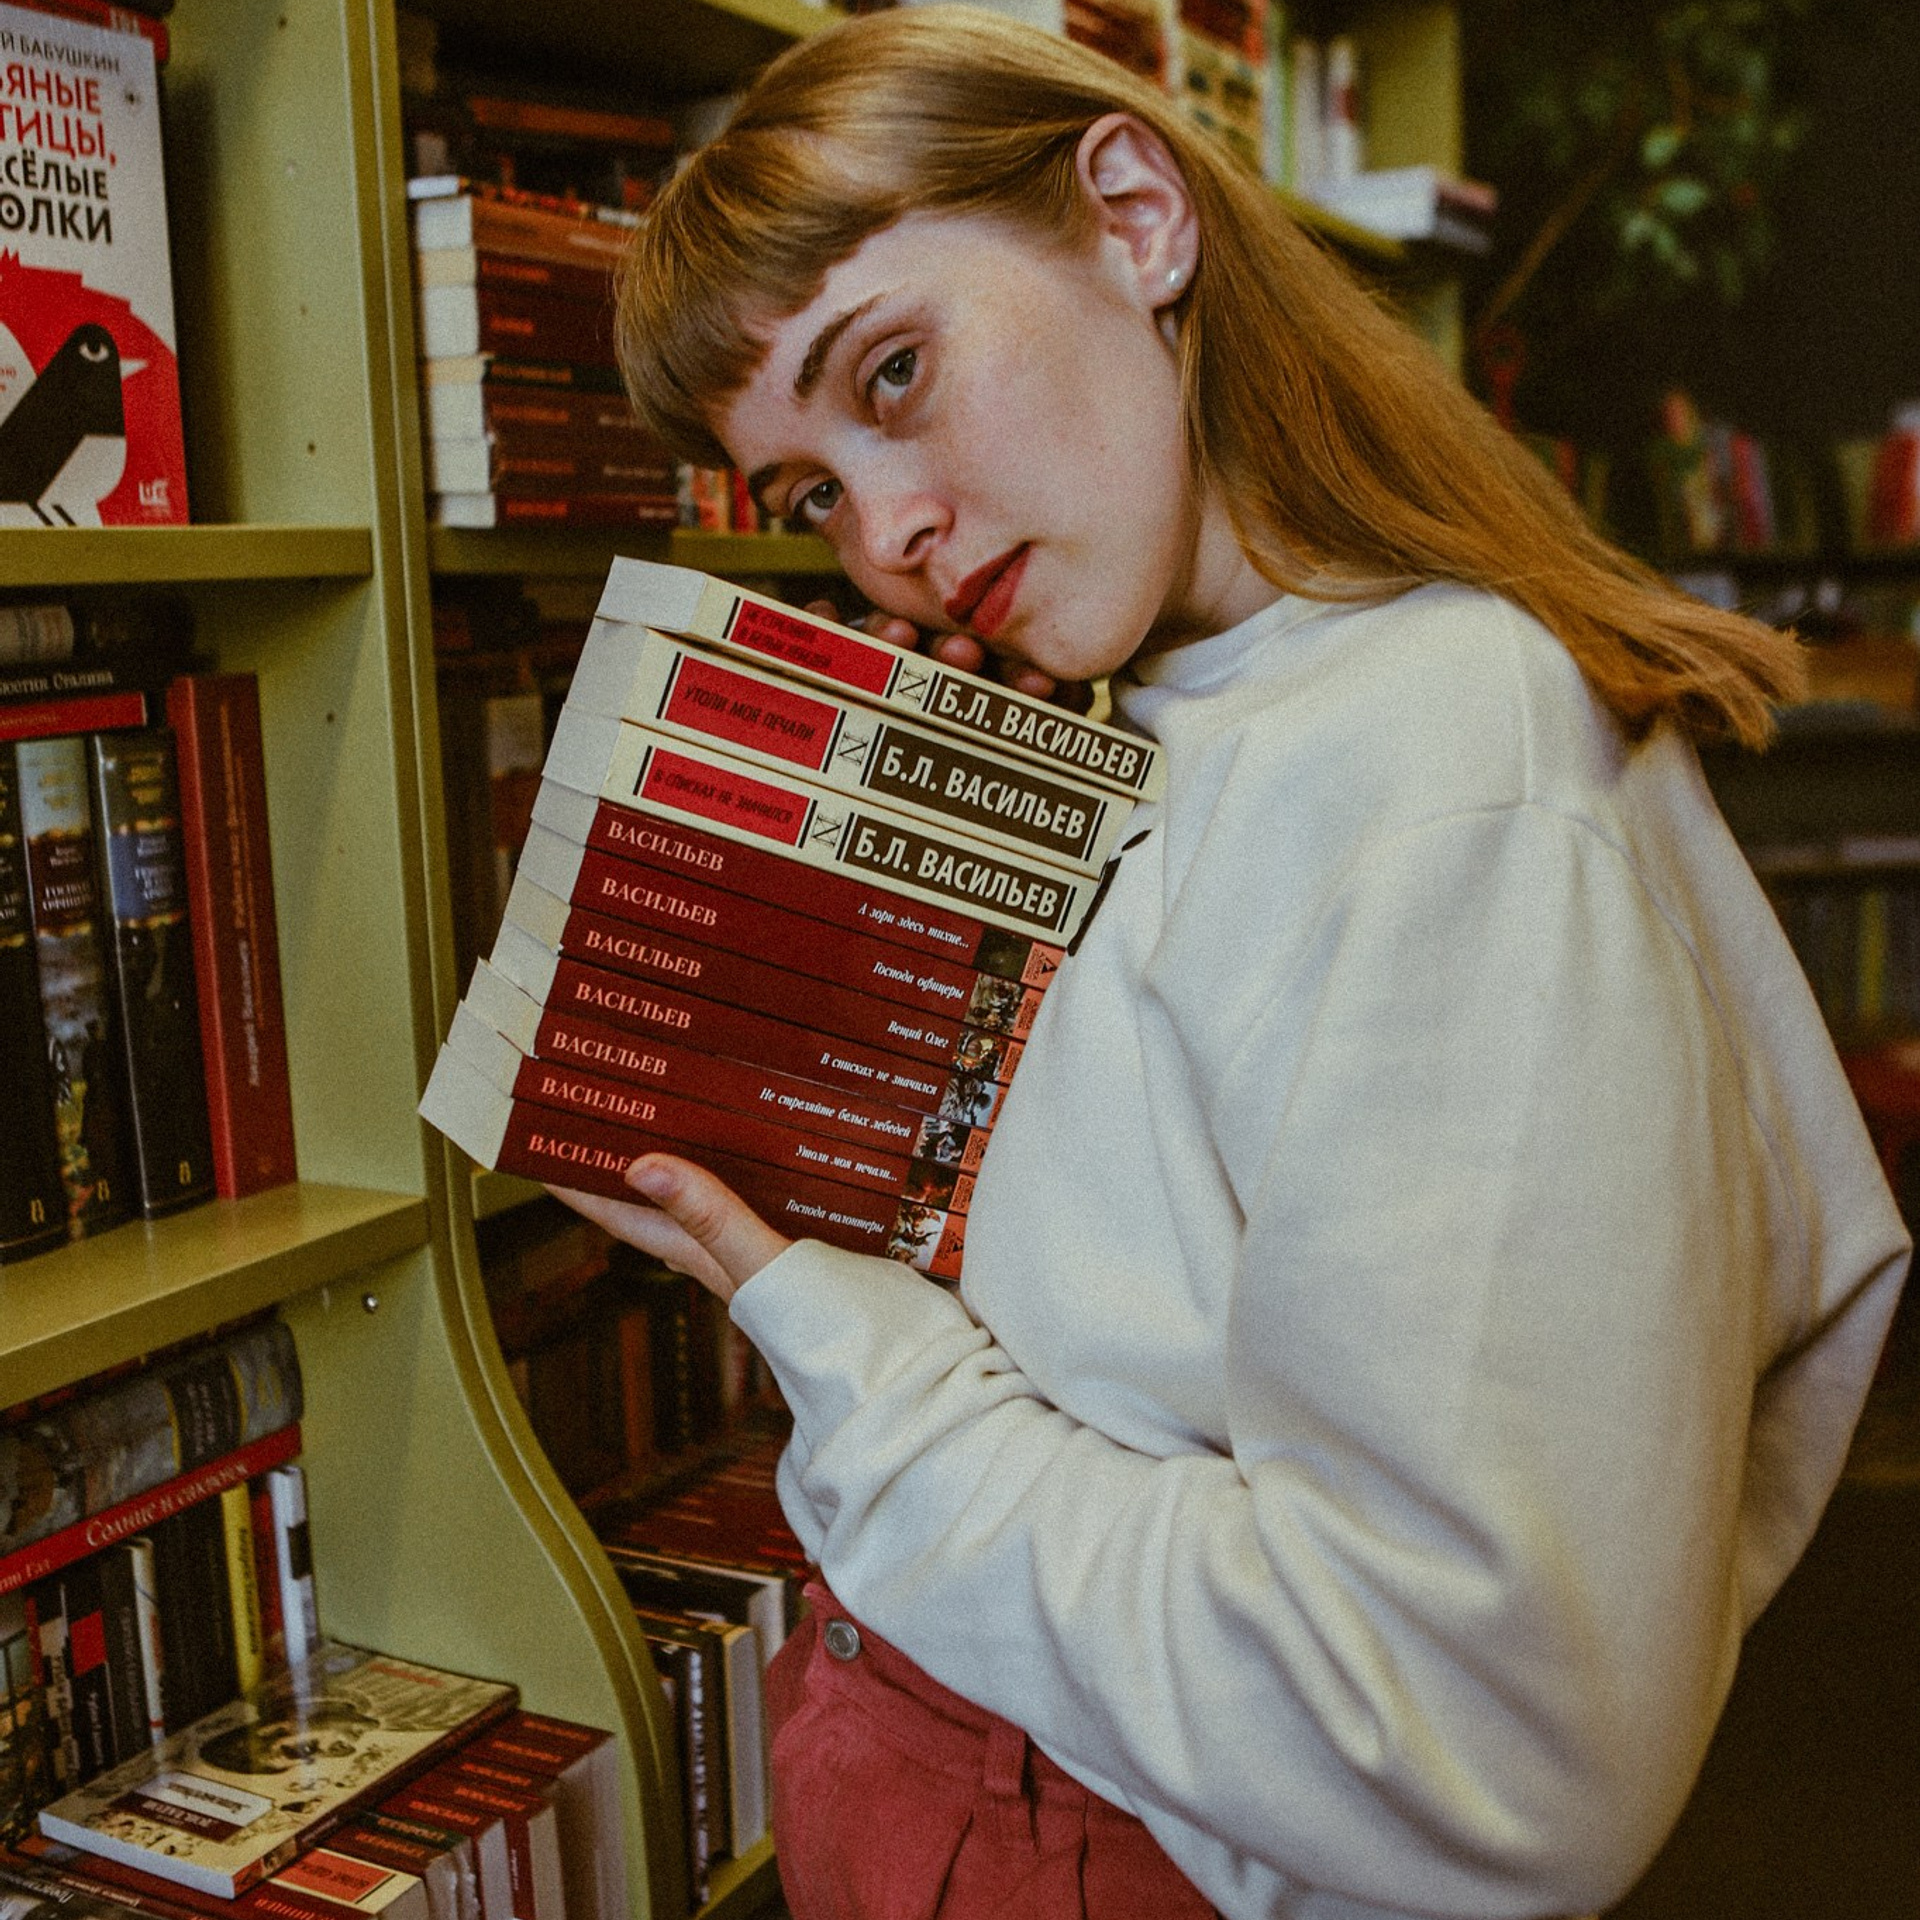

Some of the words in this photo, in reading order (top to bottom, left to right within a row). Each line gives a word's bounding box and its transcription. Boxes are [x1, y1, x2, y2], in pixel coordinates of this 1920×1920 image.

[20, 35, 120, 75] БАБУШКИН
[0, 62, 102, 114] ЯНЫЕ
[0, 149, 109, 200] СЁЛЫЕ
[938, 682, 992, 730] Б.Л.
[999, 704, 1139, 780] ВАСИЛЬЕВ
[881, 745, 937, 792] Б.Л.
[944, 766, 1087, 840] ВАСИЛЬЕВ
[607, 820, 724, 872] ВАСИЛЬЕВ
[854, 827, 910, 873] Б.Л.
[917, 848, 1059, 919] ВАСИЛЬЕВ
[600, 878, 718, 927] ВАСИЛЬЕВ
[857, 902, 868, 916] А
[869, 909, 895, 924] зори
[897, 916, 925, 934] здесь
[584, 930, 702, 978] ВАСИЛЬЕВ
[872, 961, 914, 984] Господа
[917, 977, 965, 1000] офицеры
[575, 982, 692, 1029] ВАСИЛЬЕВ
[552, 1031, 668, 1077] ВАСИЛЬЕВ
[887, 1020, 923, 1041] Вещий
[925, 1031, 949, 1048] Олег
[820, 1052, 831, 1065] В
[831, 1058, 874, 1078] списках
[876, 1069, 890, 1082] не
[891, 1074, 938, 1096] значился
[541, 1077, 657, 1121] ВАСИЛЬЕВ
[759, 1087, 775, 1101] Не
[778, 1093, 835, 1118] стреляйте
[837, 1108, 870, 1128] белых
[870, 1119, 911, 1138] лебедей
[528, 1134, 632, 1174] ВАСИЛЬЕ
[830, 1156, 852, 1169] моя
[854, 1162, 897, 1181] печали...
[786, 1199, 826, 1219] Господа
[828, 1211, 885, 1234] волонтеры
